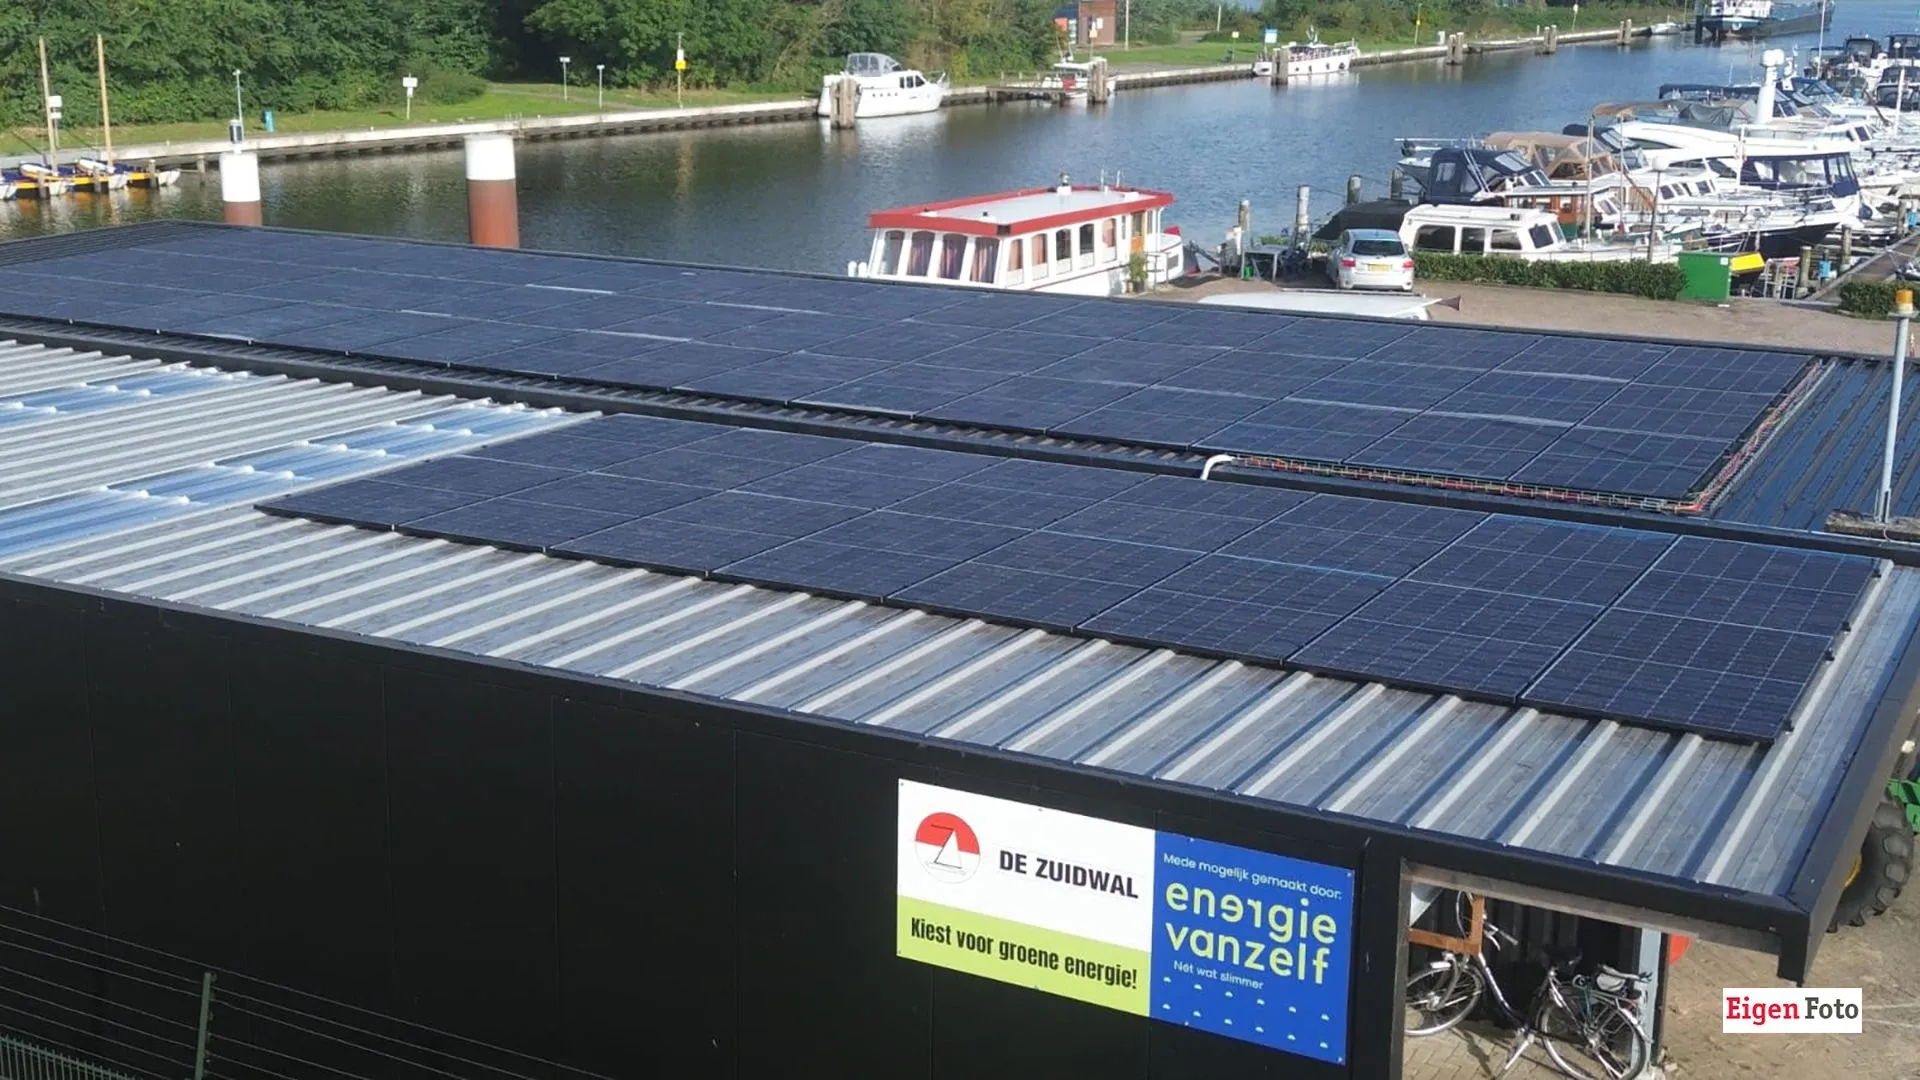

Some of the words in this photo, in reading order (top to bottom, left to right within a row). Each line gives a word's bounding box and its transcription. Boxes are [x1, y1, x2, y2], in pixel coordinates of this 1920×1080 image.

[999, 850, 1027, 874] DE
[1035, 857, 1139, 899] ZUIDWAL
[1163, 852, 1196, 869] Mede
[1199, 860, 1249, 882] mogelijk
[1251, 872, 1308, 893] gemaakt
[1310, 884, 1342, 900] door:
[1165, 881, 1337, 944] energie
[911, 917, 952, 945] Kiest
[957, 930, 994, 955] voor
[999, 940, 1059, 971] groene
[1064, 956, 1137, 989] energie!
[1165, 922, 1331, 985] vanzelf
[1196, 966, 1218, 980] wat
[1220, 969, 1265, 990] slimmer
